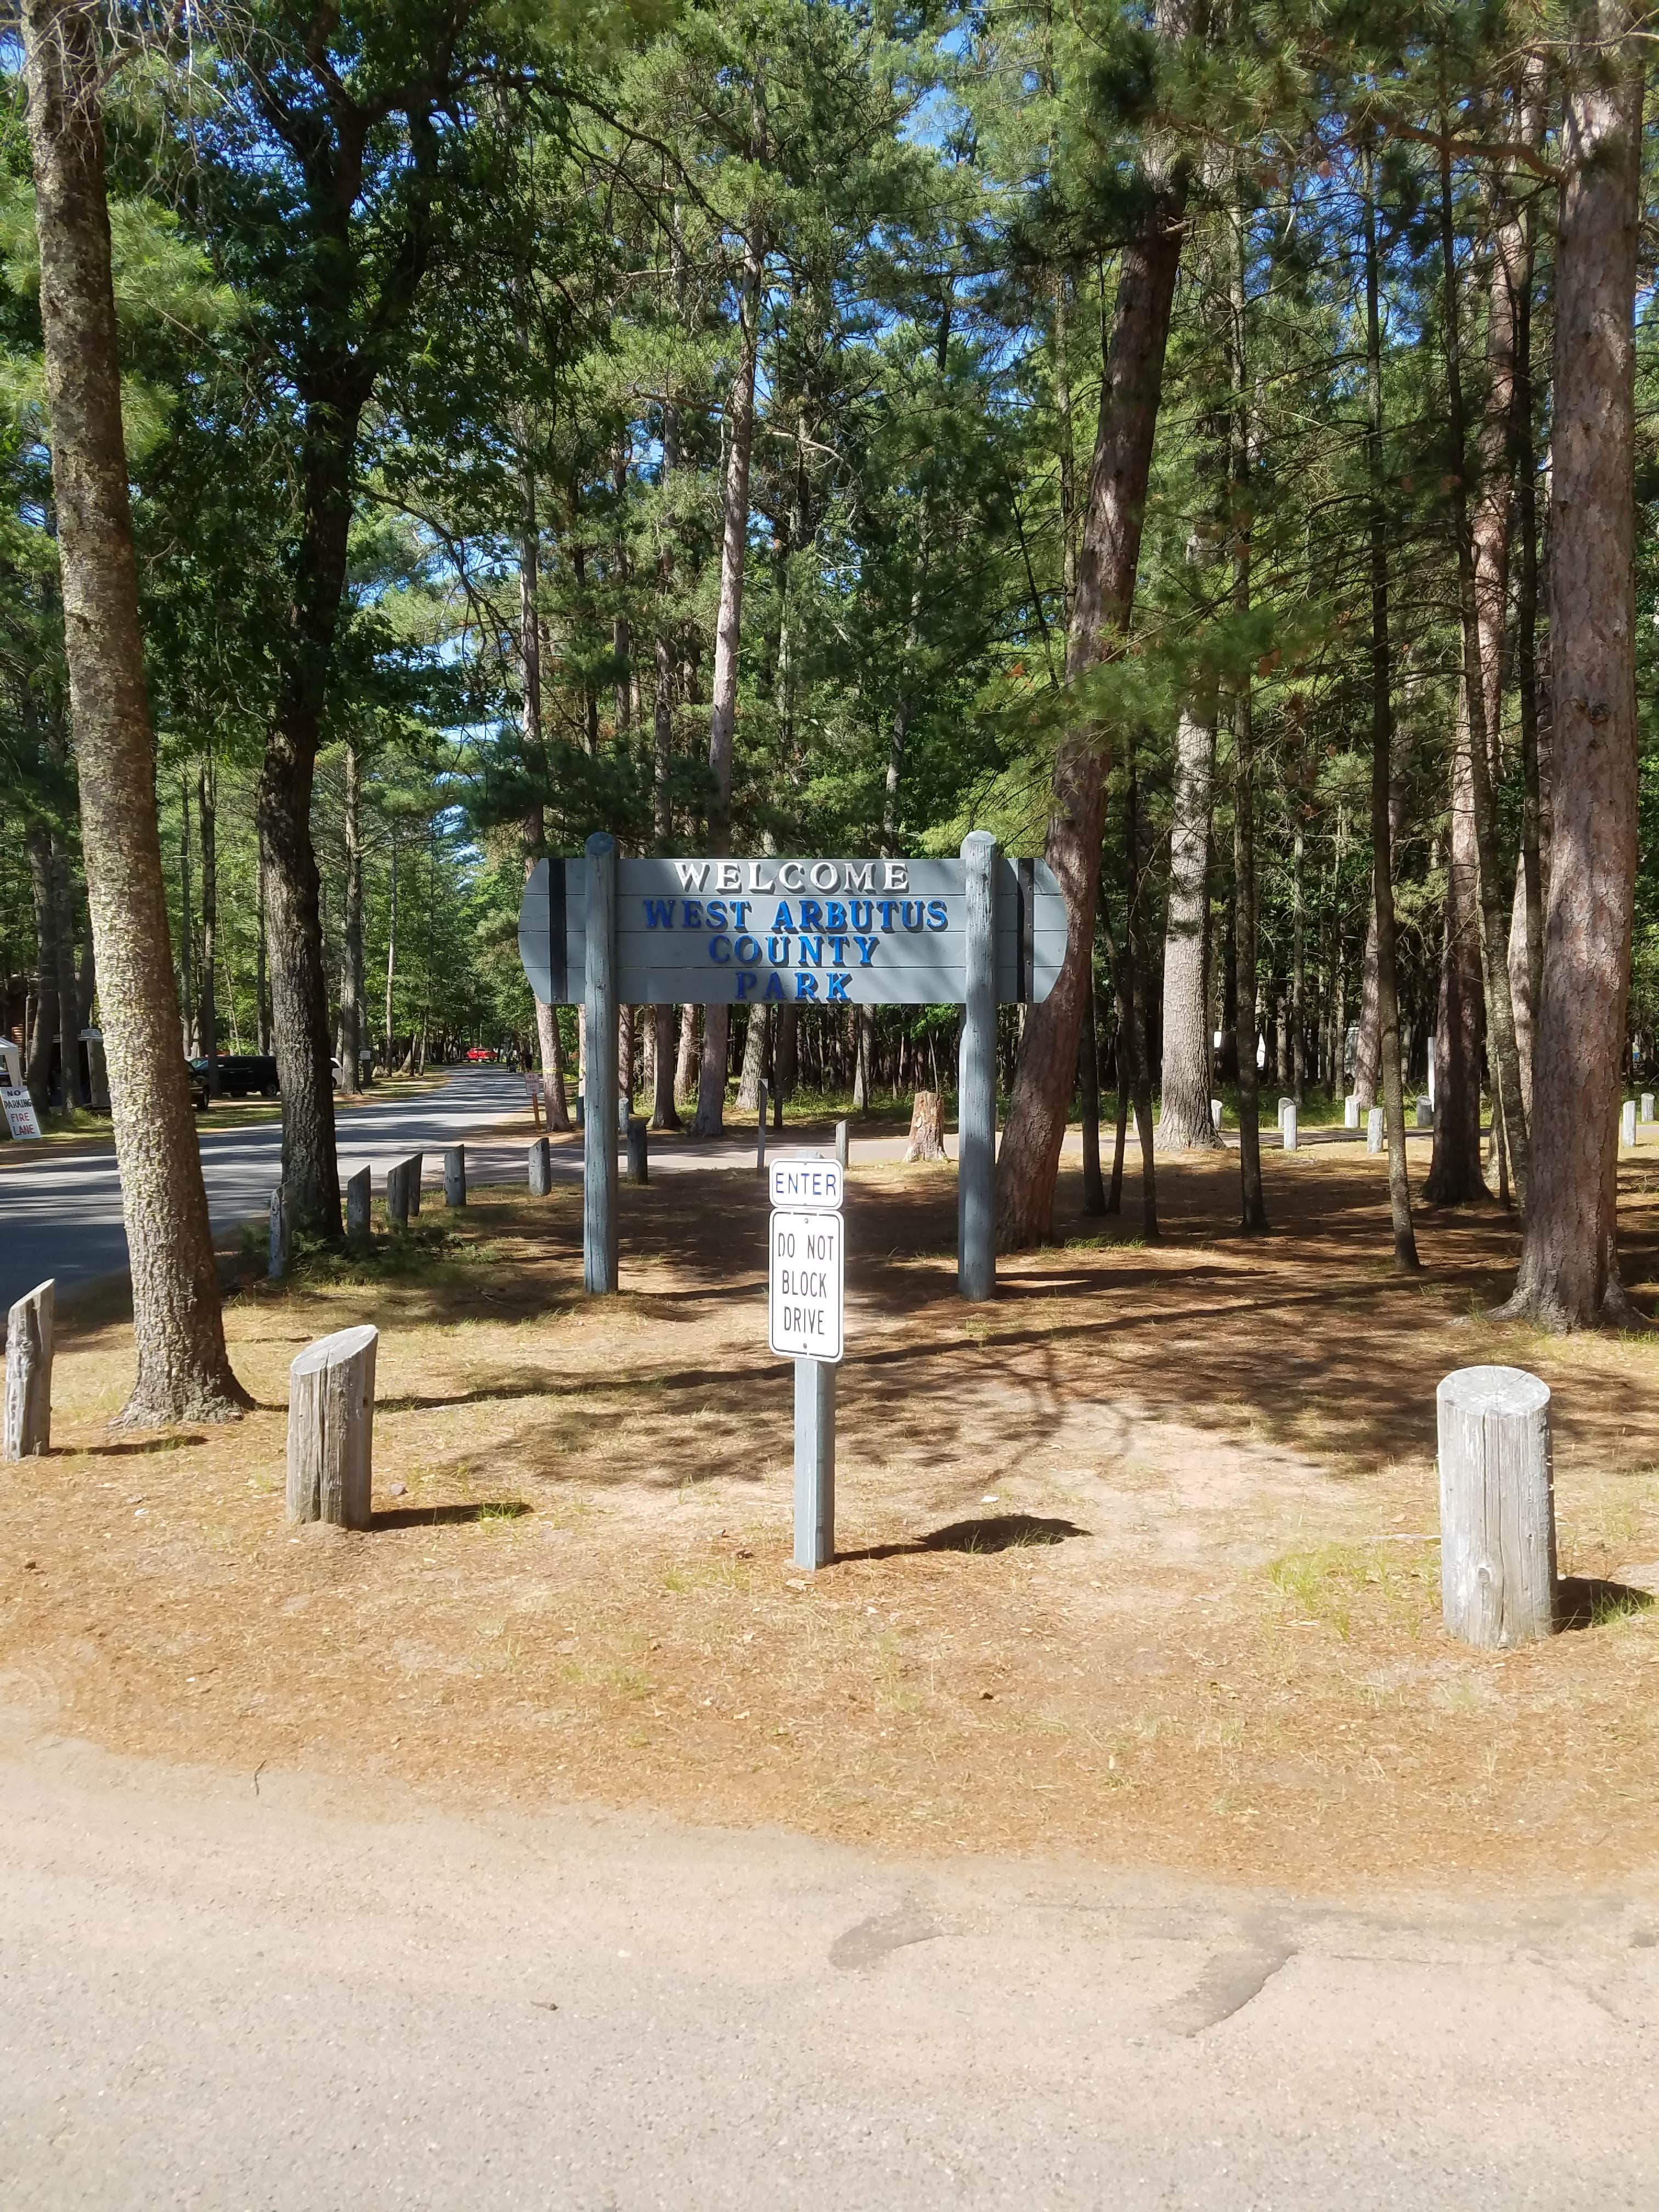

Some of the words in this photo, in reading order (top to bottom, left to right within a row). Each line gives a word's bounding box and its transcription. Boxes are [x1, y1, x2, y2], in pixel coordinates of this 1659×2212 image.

[674, 862, 908, 891] WELCOME
[643, 900, 749, 928] WEST
[772, 900, 947, 929] ARBUTUS
[709, 935, 879, 963] COUNTY
[735, 972, 851, 1000] PARK
[3, 1099, 32, 1109] PARKING
[10, 1113, 30, 1122] FIRE
[13, 1124, 36, 1136] LANE
[776, 1172, 836, 1196] ENTER
[778, 1232, 795, 1258] DO
[807, 1234, 834, 1261] NOT
[782, 1269, 827, 1298] BLOCK
[785, 1306, 825, 1335] DRIVE
